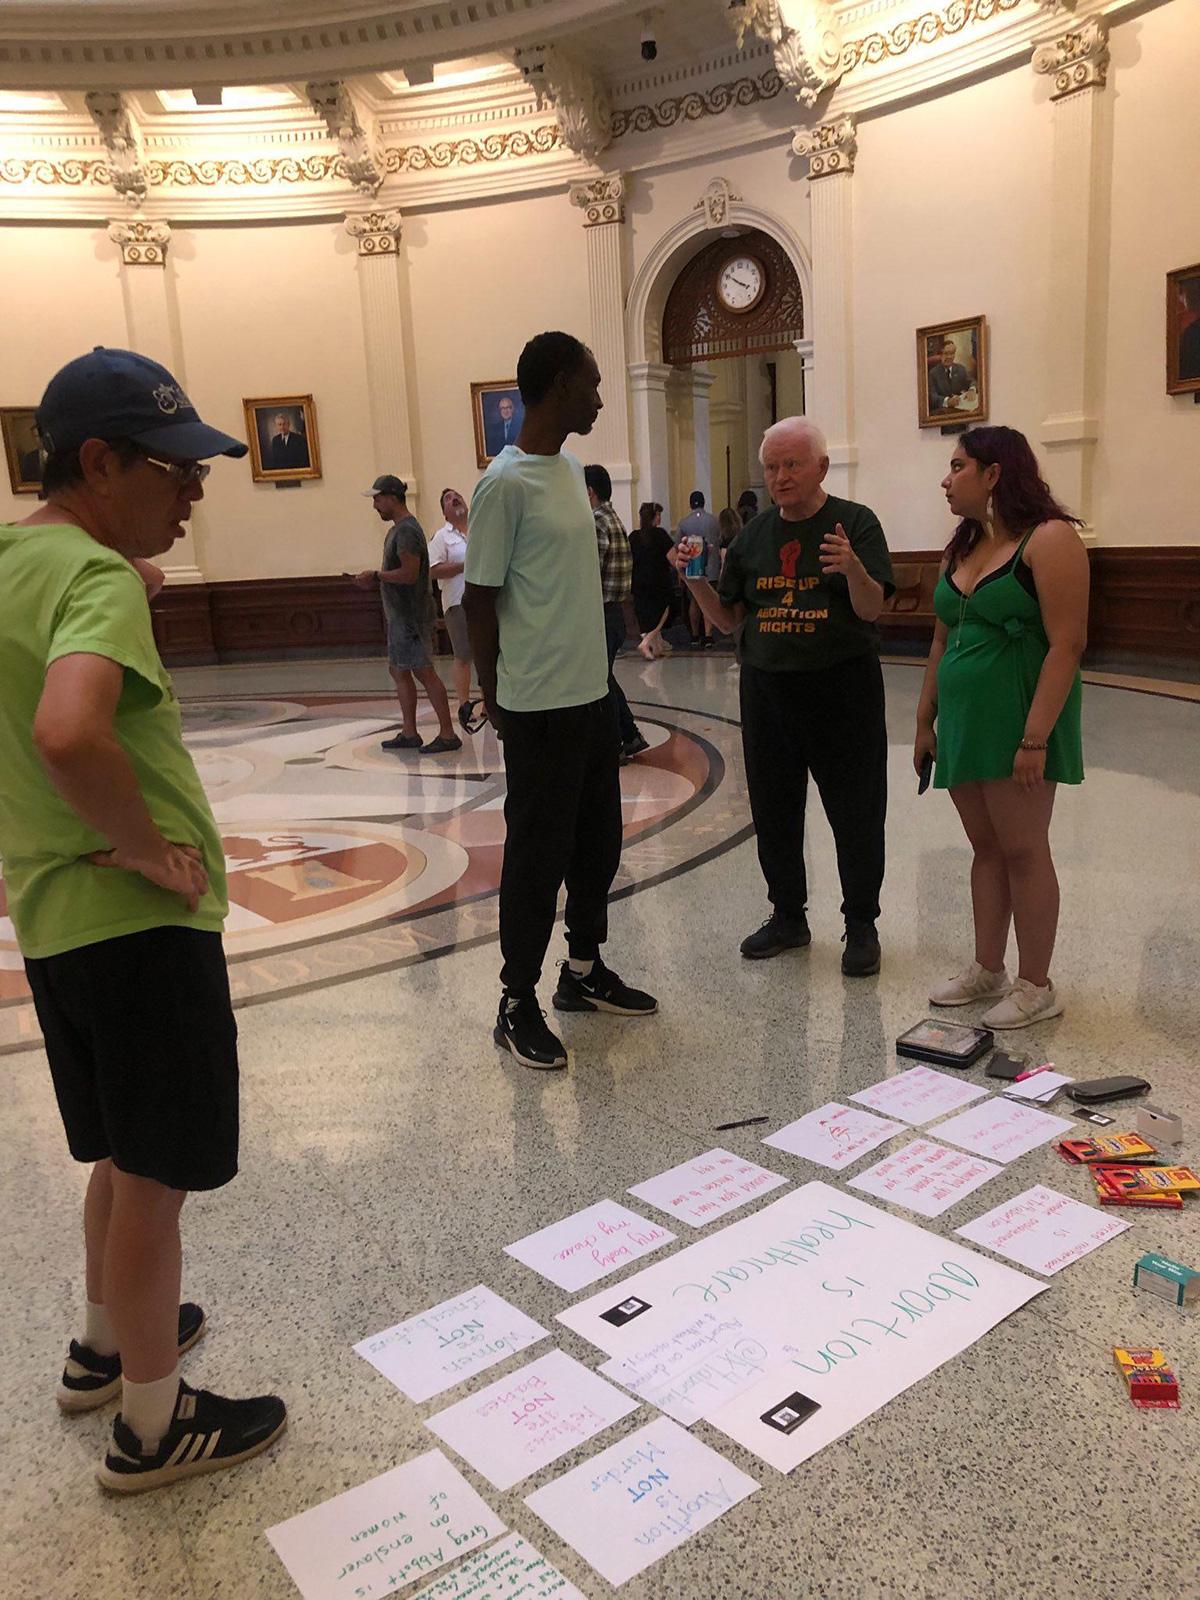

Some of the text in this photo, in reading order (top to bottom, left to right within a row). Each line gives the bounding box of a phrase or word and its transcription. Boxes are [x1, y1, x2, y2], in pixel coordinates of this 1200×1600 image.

[756, 576, 820, 591] RISE UP
[781, 591, 793, 607] 4
[756, 608, 829, 620] ABORTION
[759, 621, 816, 633] RIGHTS
[596, 1221, 628, 1235] my
[592, 1228, 666, 1266] my body
[673, 1209, 875, 1320] healthcare
[823, 1277, 863, 1297] is
[439, 1320, 485, 1349] NOT
[792, 1262, 979, 1374] abortion
[512, 1392, 556, 1425] NOT
[591, 1440, 665, 1492] Murder
[628, 1469, 670, 1503] NOT
[656, 1489, 682, 1508] is
[351, 1492, 447, 1541] of women
[634, 1478, 734, 1545] Abortion
[339, 1514, 449, 1579] an enslaver
[447, 1526, 488, 1546] Greg
[389, 1548, 443, 1584] Abbott
